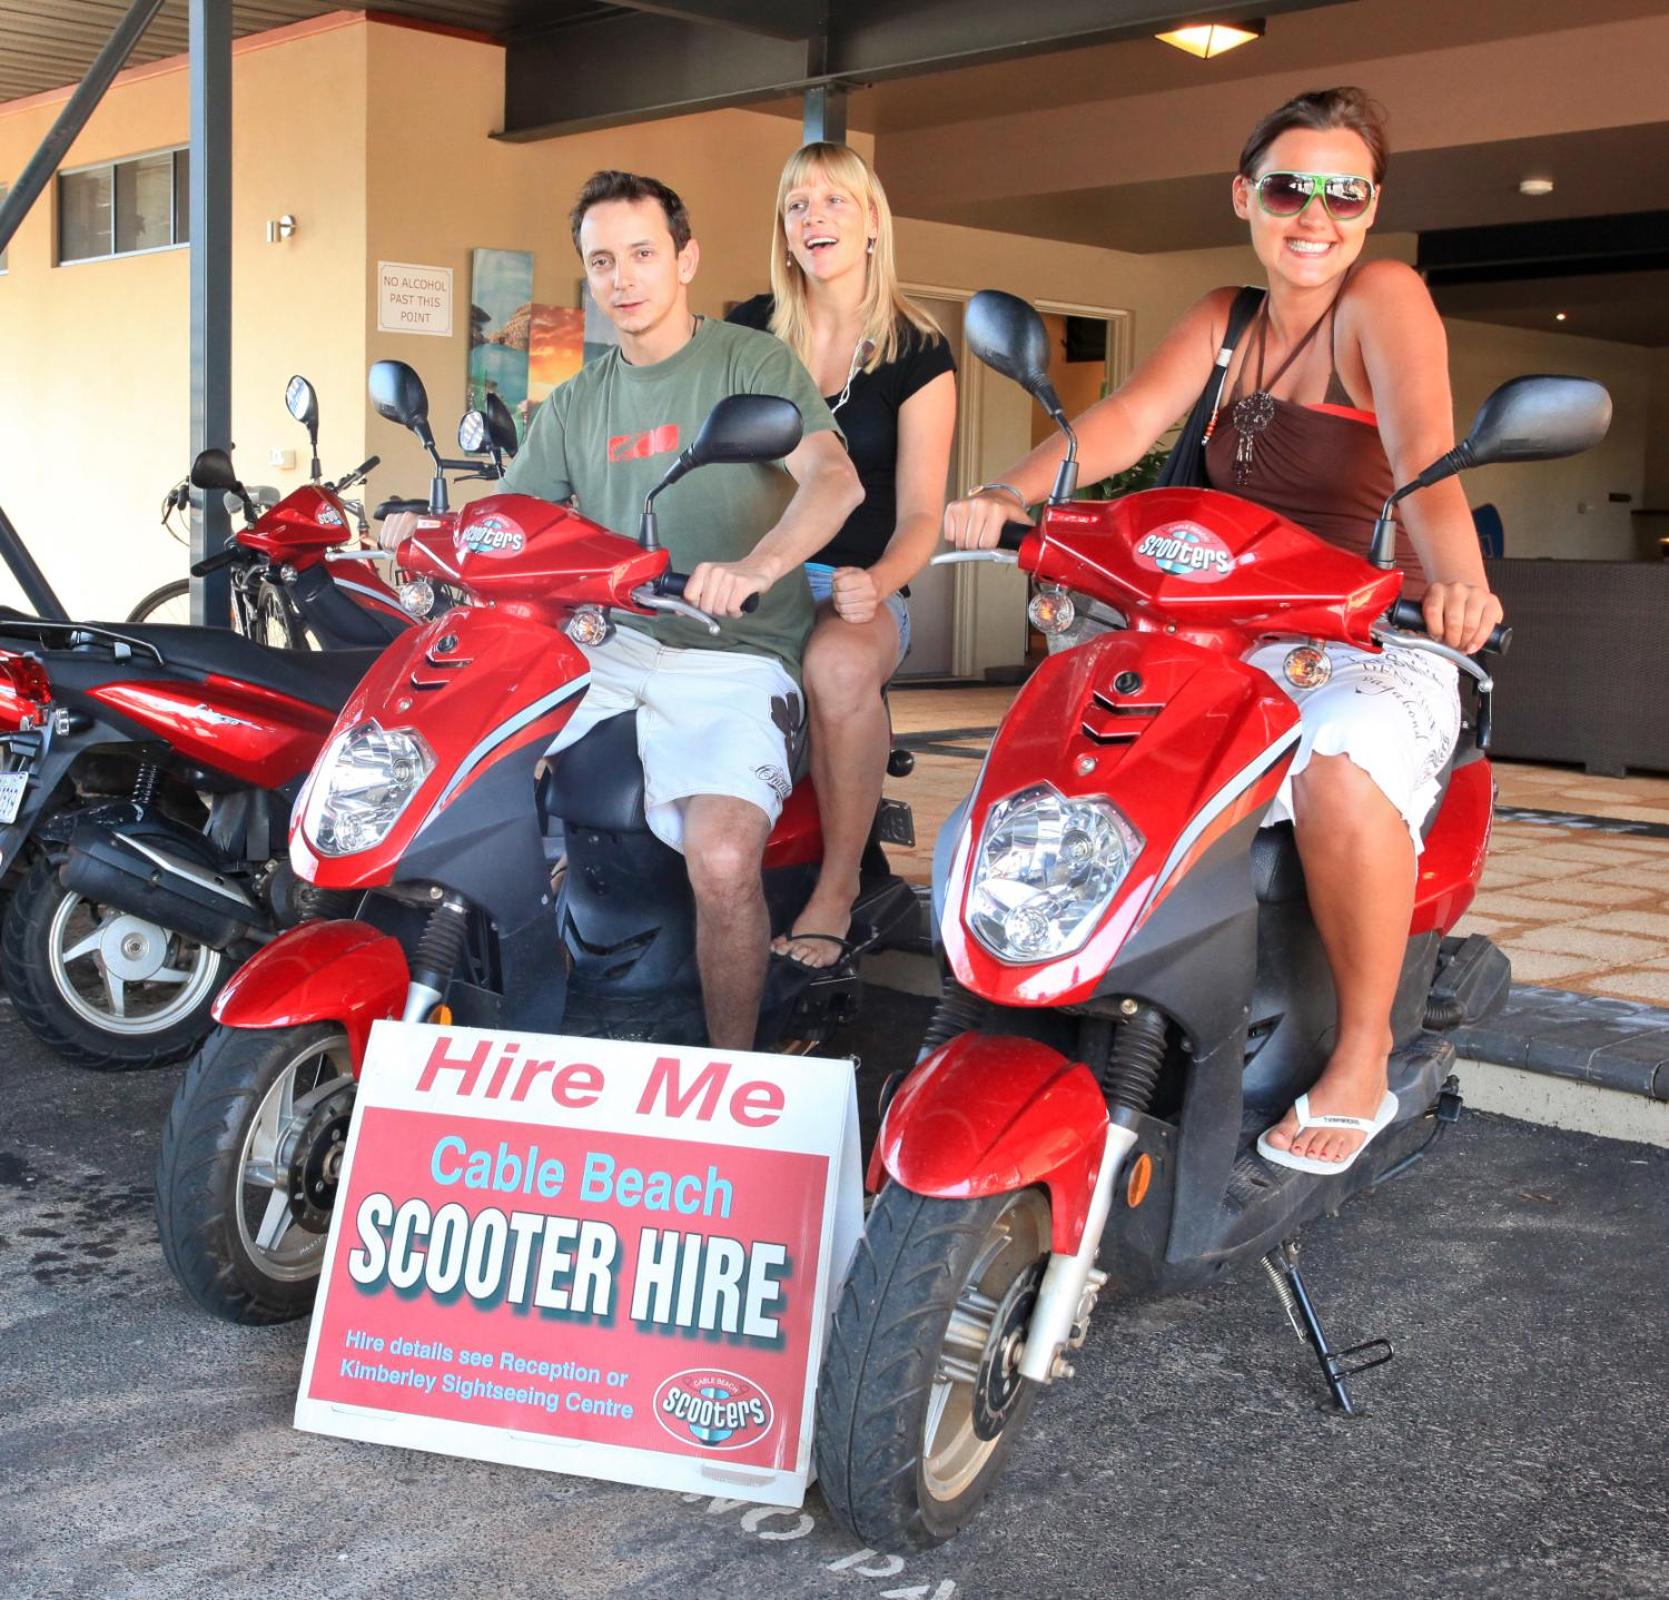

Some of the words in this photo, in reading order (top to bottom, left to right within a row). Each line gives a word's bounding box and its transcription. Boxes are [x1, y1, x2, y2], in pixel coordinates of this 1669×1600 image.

[383, 276, 399, 287] NO
[401, 278, 447, 292] ALCOHOL
[390, 293, 415, 305] PAST
[417, 296, 441, 308] THIS
[400, 311, 432, 323] POINT
[415, 1037, 605, 1108] Hire
[635, 1056, 786, 1127] Me
[430, 1136, 565, 1197] Cable
[579, 1152, 734, 1218] Beach
[348, 1193, 618, 1316] SCOOTER
[629, 1227, 788, 1339] HIRE
[345, 1329, 385, 1352] Hire
[390, 1336, 453, 1364] details
[458, 1350, 494, 1368] see
[499, 1351, 600, 1388] Reception
[605, 1371, 630, 1386] or
[340, 1358, 437, 1394] Kimberley
[441, 1372, 560, 1412] Sightseeing
[564, 1391, 634, 1420] Centre
